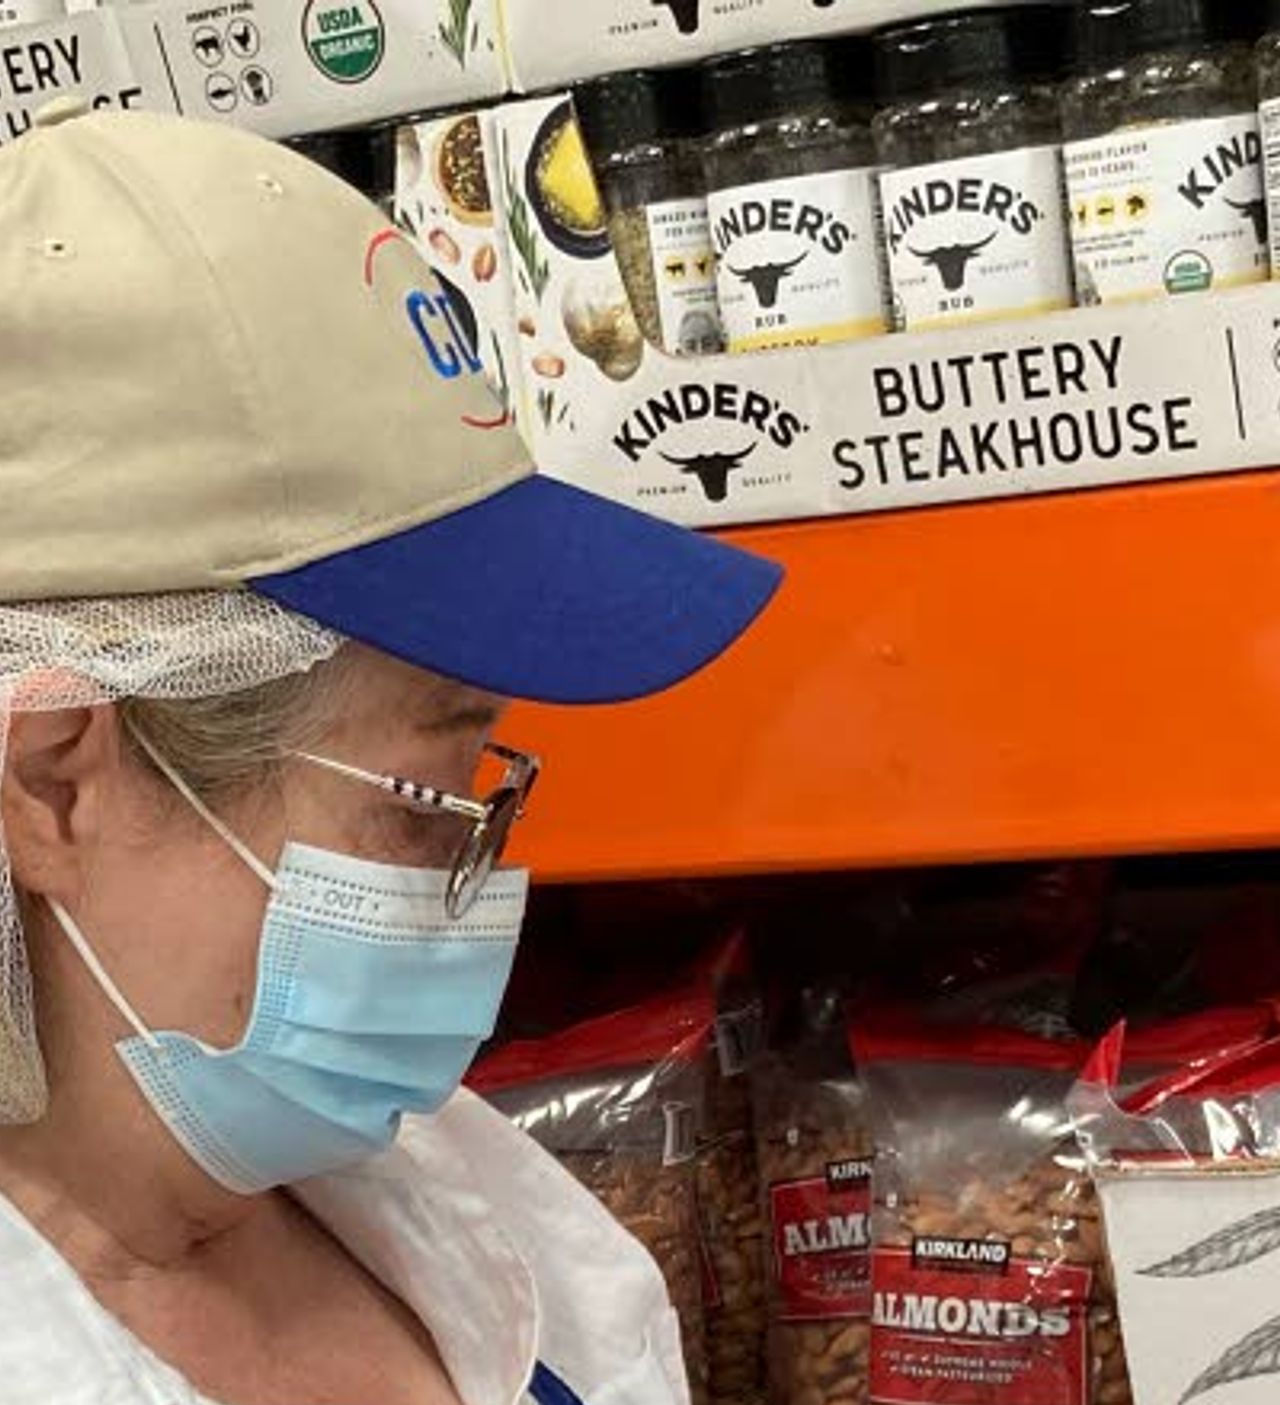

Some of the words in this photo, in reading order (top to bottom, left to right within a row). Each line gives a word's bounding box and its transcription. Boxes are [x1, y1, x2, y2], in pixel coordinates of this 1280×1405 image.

[316, 5, 363, 33] USDA
[873, 336, 1122, 418] BUTTERY
[612, 382, 810, 462] KINDER'S
[831, 397, 1199, 491] STEAKHOUSE
[783, 1213, 871, 1255] ALM
[914, 1240, 1007, 1263] KIRKLAND
